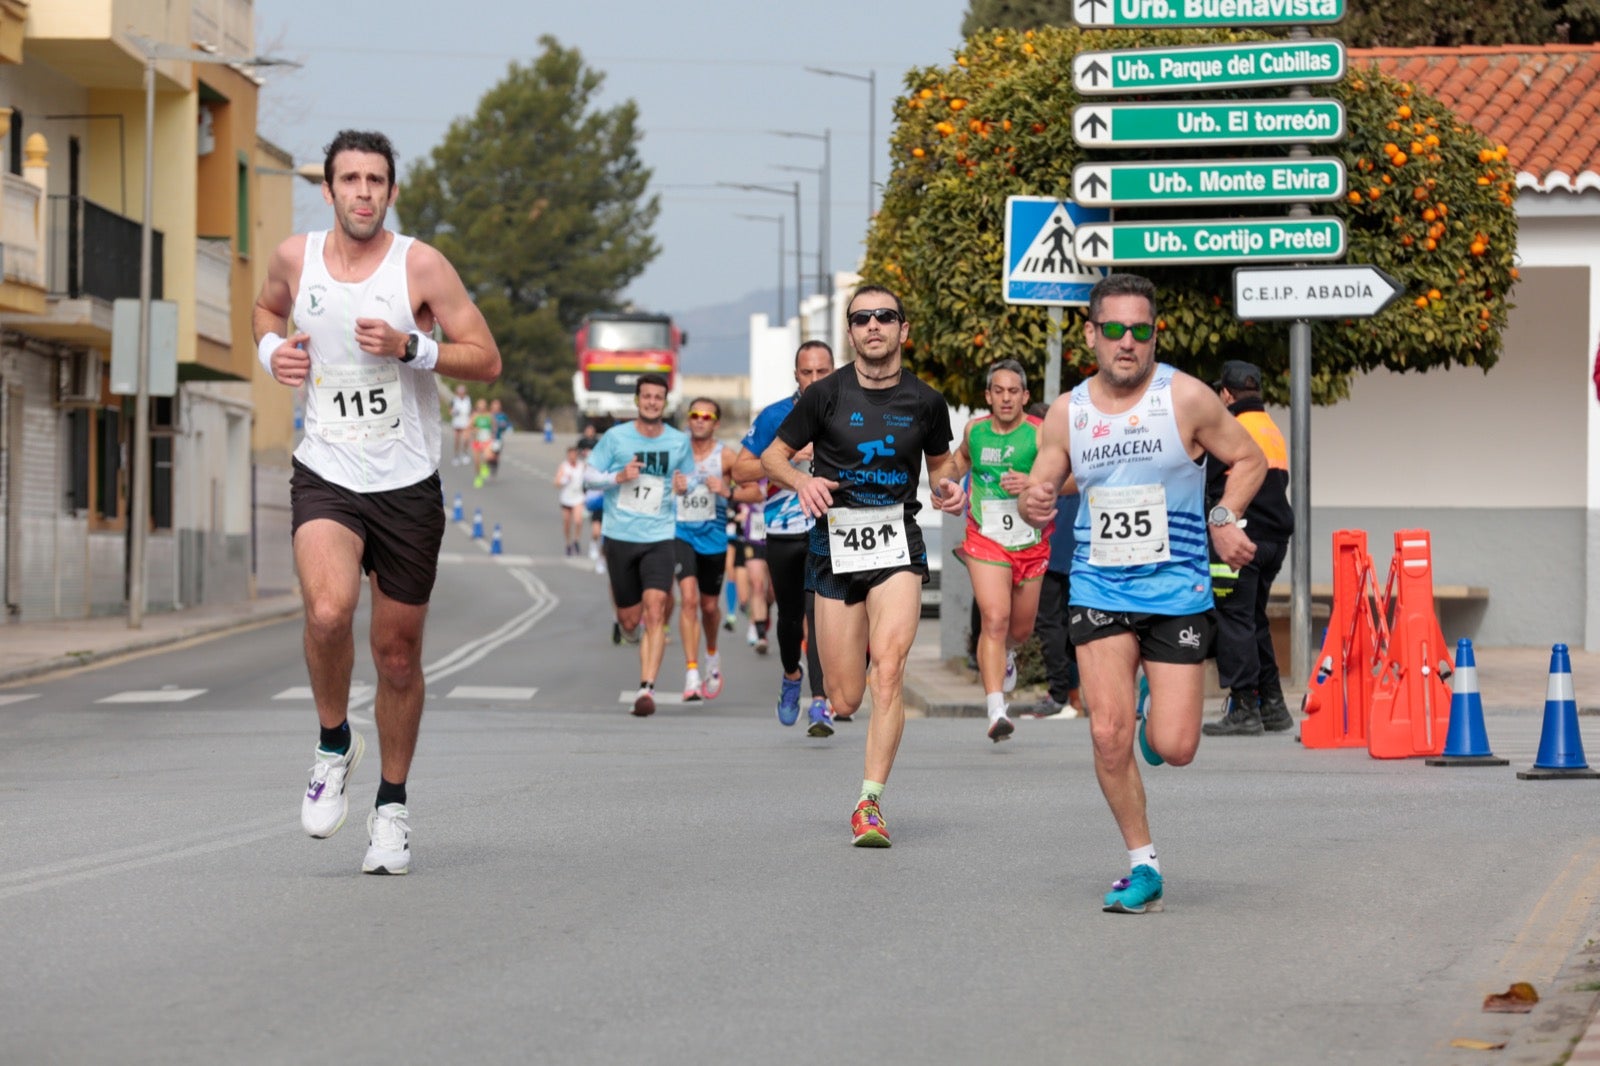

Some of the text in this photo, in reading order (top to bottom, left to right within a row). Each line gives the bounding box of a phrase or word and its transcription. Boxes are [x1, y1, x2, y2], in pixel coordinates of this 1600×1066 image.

[1121, 0, 1337, 20] Urb. Buenavista
[1117, 50, 1332, 81] Urb. Parque del Cubillas
[1177, 109, 1330, 133] Urb. El torreón
[1149, 168, 1330, 194] Urb. Monte Elvira
[1144, 227, 1331, 254] Urb. Cortijo Pretel
[1242, 281, 1373, 300] C.E.I.P. ABADÍA
[333, 388, 387, 417] 115
[1081, 438, 1163, 464] MARACENA
[1117, 456, 1153, 464] ATLETISMO
[633, 486, 651, 499] 17
[683, 495, 708, 509] 669
[1002, 514, 1013, 531] 9
[1100, 510, 1152, 539] 235
